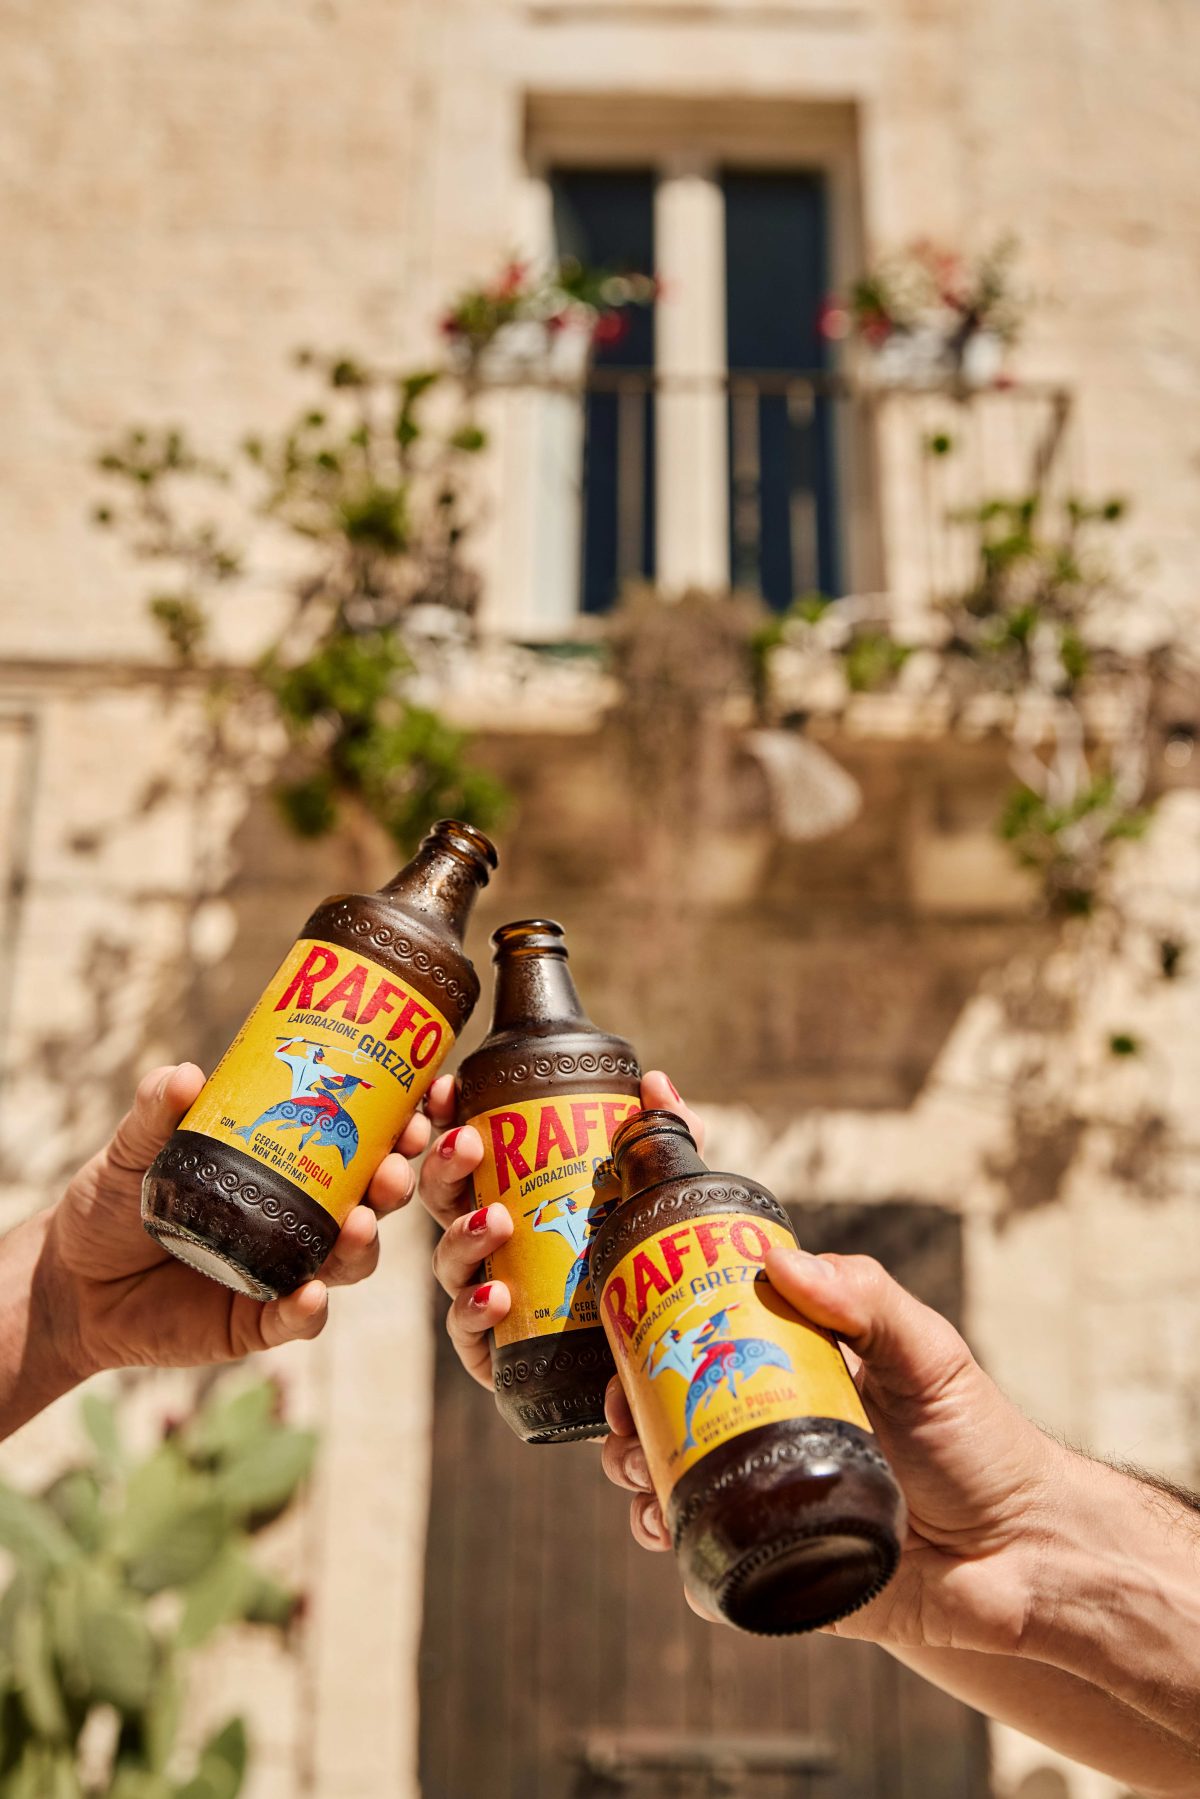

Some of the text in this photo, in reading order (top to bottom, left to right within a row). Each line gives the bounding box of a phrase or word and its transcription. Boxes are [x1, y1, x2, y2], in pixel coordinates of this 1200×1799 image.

[274, 945, 442, 1070] RAFFO
[288, 1013, 415, 1093] LAVORAZIONE GREZZA
[220, 1116, 236, 1129] CON
[251, 1143, 309, 1185] NON RAFFINATI
[254, 1133, 333, 1190] CEREALI DI PUGLIA
[520, 1160, 588, 1197] LAVORAZIONE
[534, 1300, 597, 1320] CON CERE
[603, 1220, 772, 1358] RAFFO
[579, 1311, 598, 1323] NON
[632, 1286, 686, 1356] LAVORAZIONE
